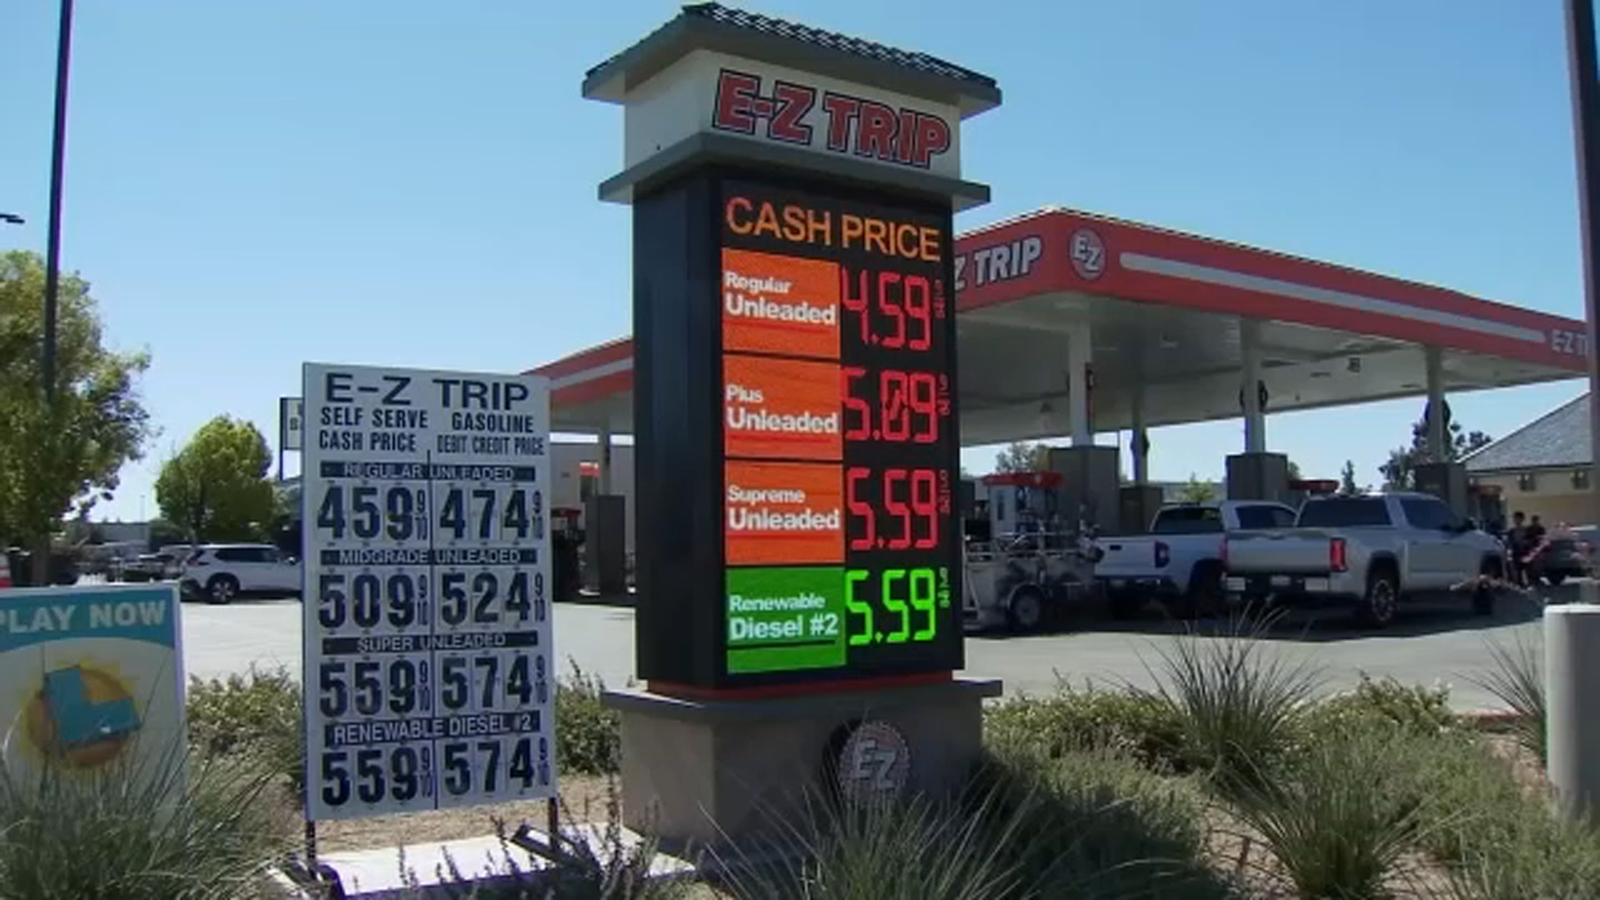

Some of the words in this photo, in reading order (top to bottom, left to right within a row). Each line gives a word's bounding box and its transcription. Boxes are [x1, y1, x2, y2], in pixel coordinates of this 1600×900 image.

[712, 68, 816, 145] E-Z
[823, 91, 951, 169] TRIP
[726, 197, 831, 245] CASH
[841, 214, 941, 261] PRICE
[974, 237, 1042, 286] TRIP
[725, 271, 792, 295] Regular
[725, 294, 836, 325] Unleaded
[842, 266, 932, 350] 4.59
[326, 373, 411, 405] E-Z
[432, 379, 529, 410] TRIP
[726, 384, 763, 403] Plus
[840, 366, 938, 443] 5.09
[320, 407, 363, 427] SELF
[372, 409, 428, 429] SERVE
[452, 412, 534, 433] GASOLINE
[727, 406, 839, 433] Unleaded
[319, 430, 363, 451] CASH
[370, 432, 416, 453] PRICE
[437, 434, 468, 454] DEBIT
[472, 436, 510, 455] CREDIT
[344, 463, 423, 479] REGULAR
[429, 466, 515, 480] UNLEADED
[728, 485, 805, 505] Supreme
[847, 467, 938, 550] 5.59
[729, 508, 840, 530] Unleaded
[340, 550, 428, 564] MIDGRADE
[436, 549, 520, 564] UNLEADED
[729, 593, 826, 612] Renewable
[845, 569, 936, 645] 5.59
[0, 605, 76, 634] LAY
[90, 600, 165, 628] NOW
[730, 615, 803, 640] Diesel
[810, 613, 839, 635] #2
[358, 636, 413, 652] SUPER
[420, 633, 506, 650] UNLEADED
[334, 720, 444, 744] RENEWABLE
[450, 716, 510, 735] DIESEL
